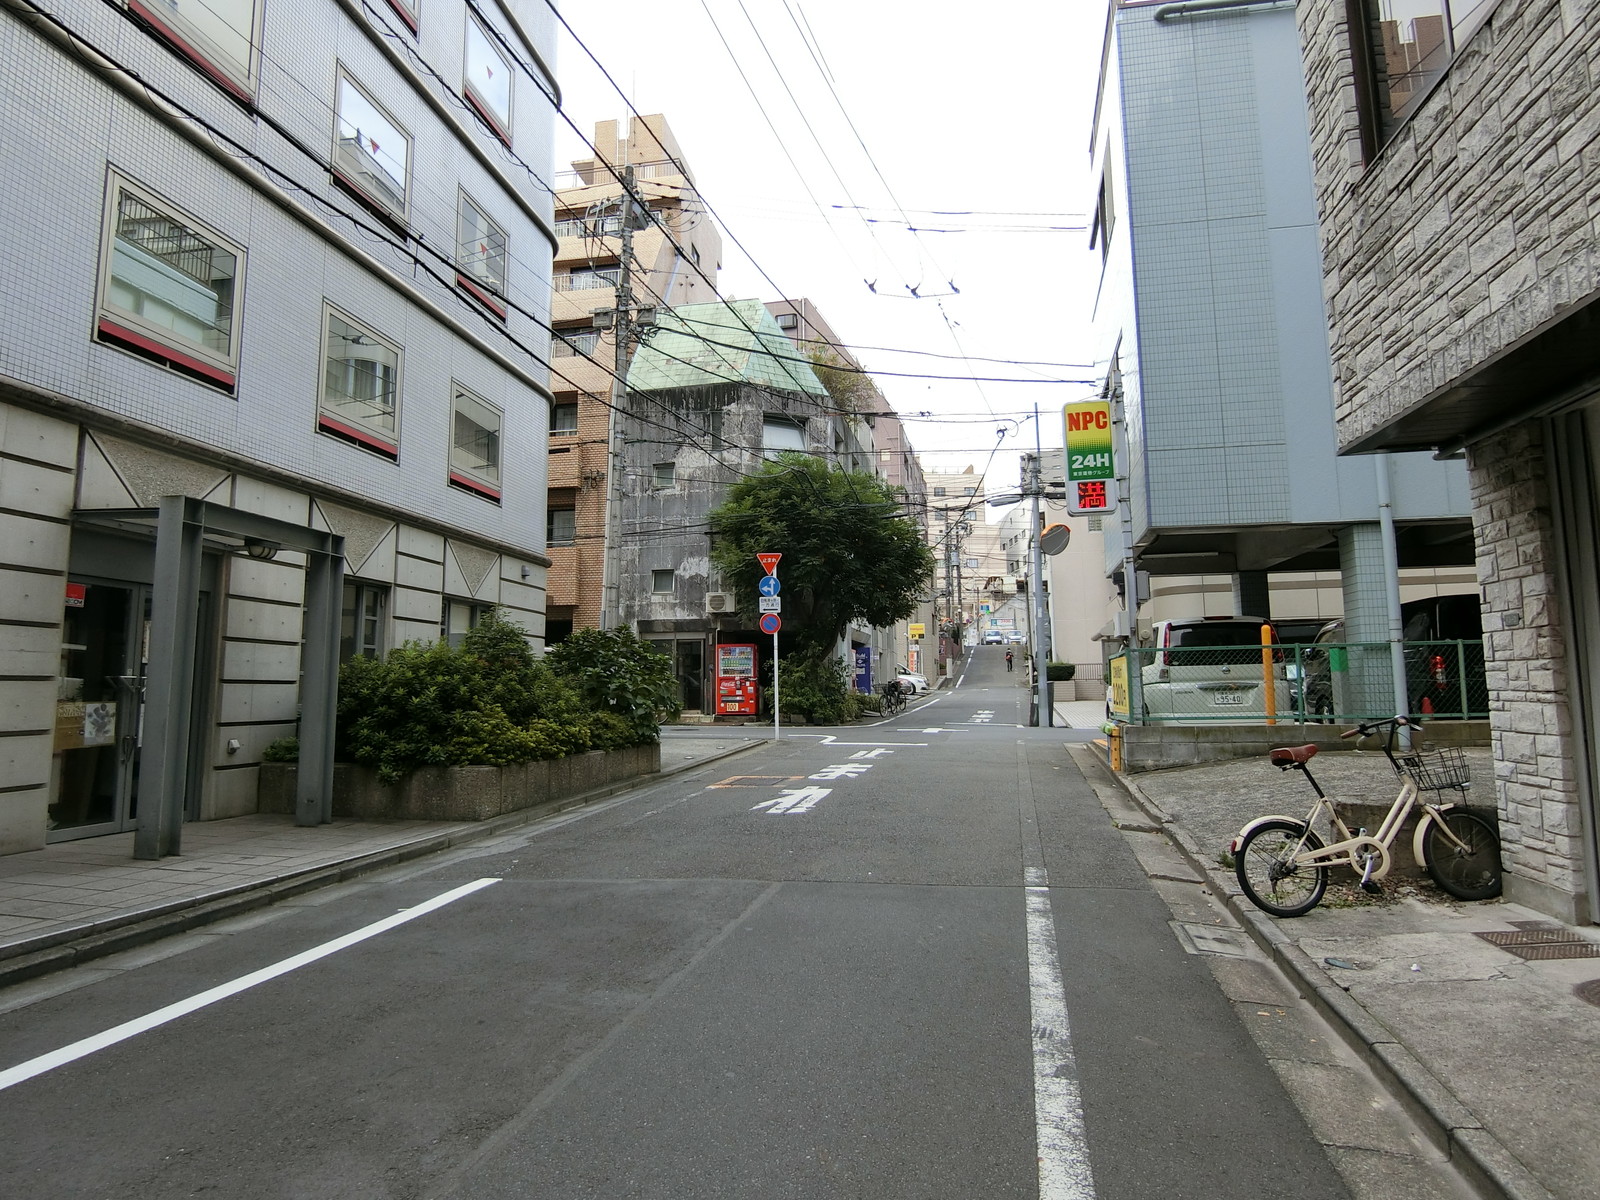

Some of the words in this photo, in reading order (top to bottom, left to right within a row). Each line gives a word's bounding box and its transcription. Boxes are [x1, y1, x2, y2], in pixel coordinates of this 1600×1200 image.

[1067, 410, 1108, 432] NPC
[1071, 453, 1110, 469] 24H
[1078, 482, 1106, 508] 満
